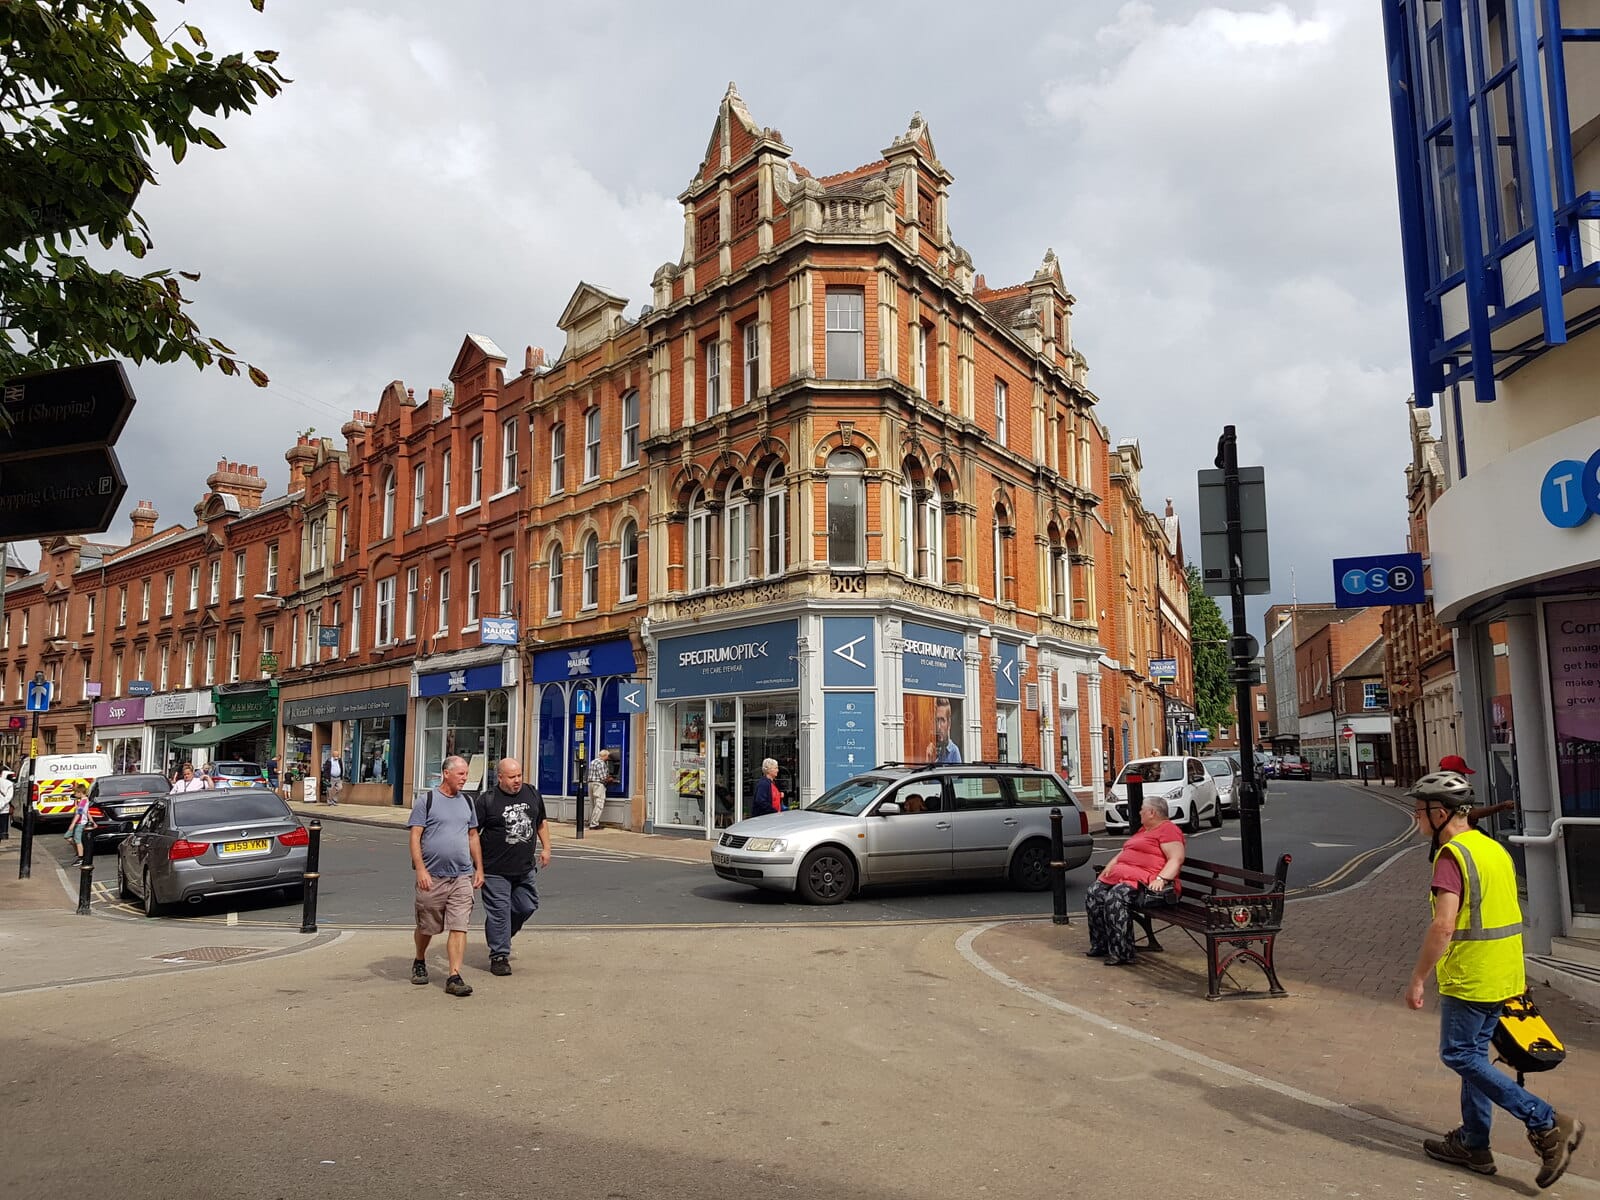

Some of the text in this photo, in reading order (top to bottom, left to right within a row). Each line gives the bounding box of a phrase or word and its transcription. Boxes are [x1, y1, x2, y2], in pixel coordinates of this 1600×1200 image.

[29, 395, 96, 423] (Shopping)
[43, 484, 82, 502] Centre
[1350, 572, 1407, 589] TSB
[484, 627, 516, 636] HALIFAX
[567, 657, 590, 668] HALIFAX
[1563, 662, 1582, 674] get
[448, 676, 466, 685] HALIFAX
[1565, 678, 1593, 688] make
[1567, 696, 1595, 706] grow
[109, 706, 126, 719] Scope
[73, 763, 97, 771] Quinn
[224, 839, 267, 852] EJ59 YKN
